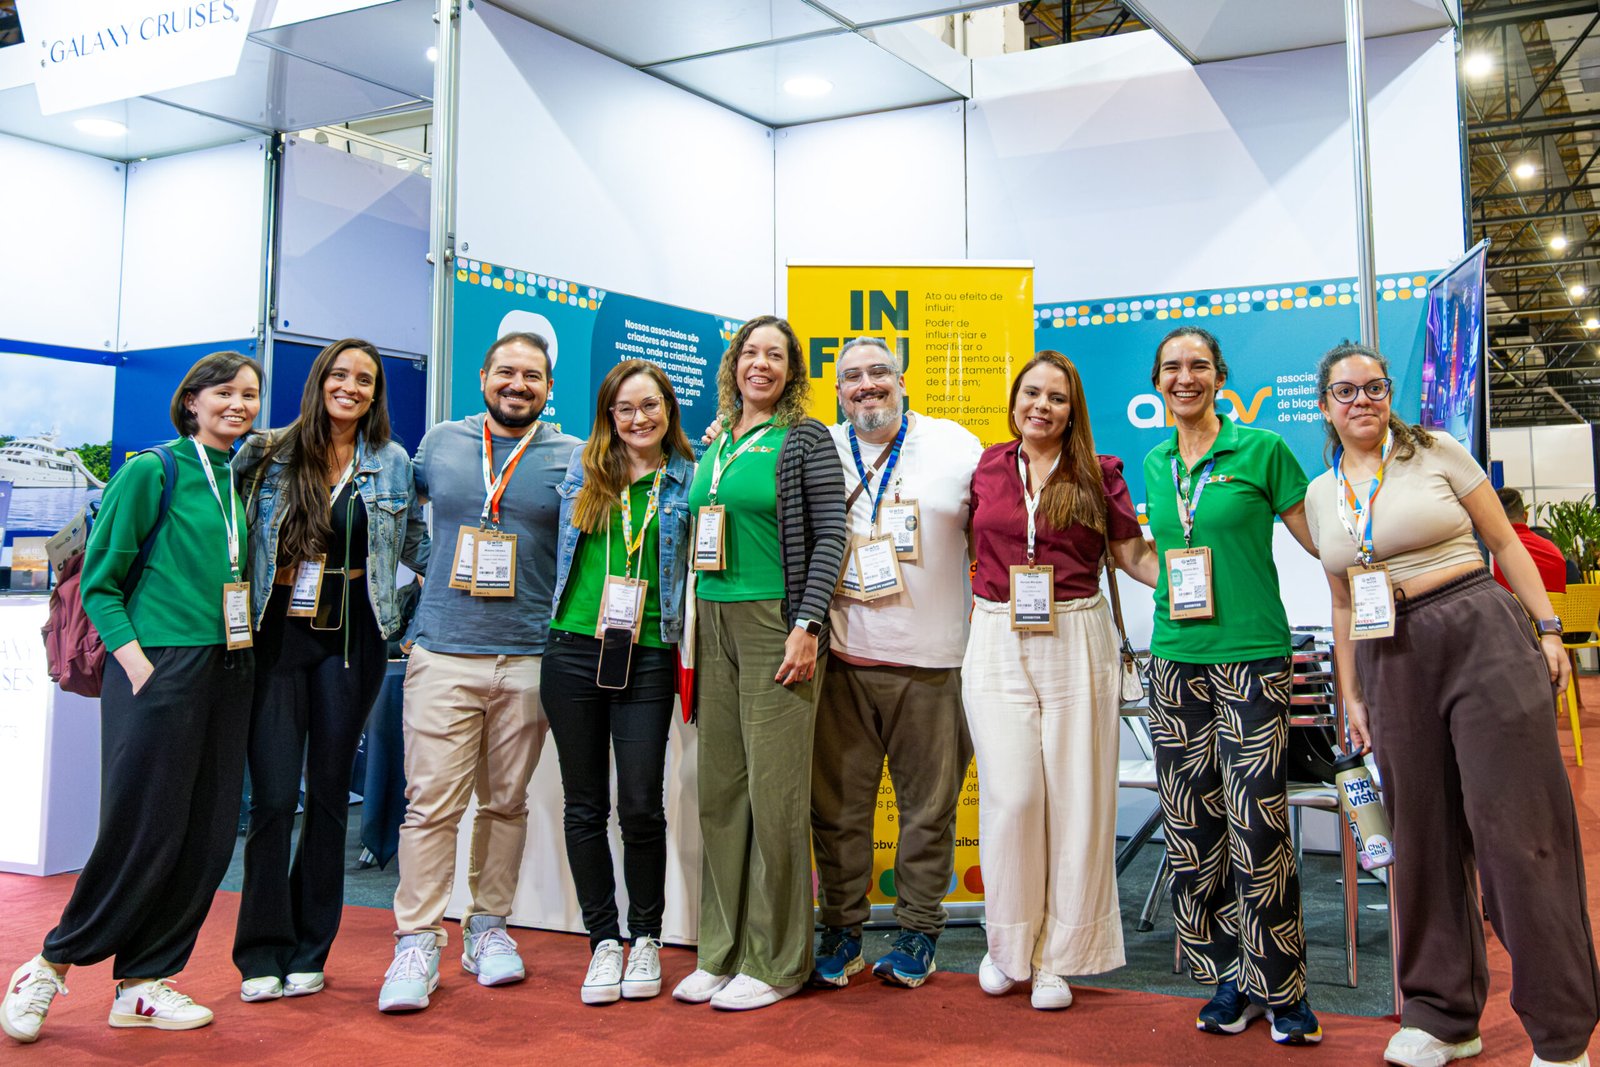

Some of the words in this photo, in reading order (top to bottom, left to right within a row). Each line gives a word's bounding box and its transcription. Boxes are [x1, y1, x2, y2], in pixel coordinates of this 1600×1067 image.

[50, 21, 133, 63] GALAXY
[140, 0, 235, 40] CRUISES
[925, 292, 942, 300] Ato
[944, 293, 957, 301] ou
[959, 292, 987, 301] efeito
[990, 292, 1003, 301] de
[850, 290, 909, 331] IN
[925, 303, 955, 313] influir;
[925, 319, 954, 328] Poder
[956, 319, 969, 328] de
[625, 319, 649, 332] Nossos
[650, 326, 687, 340] associados
[688, 333, 699, 343] são
[925, 330, 977, 339] influenciar
[627, 332, 659, 345] criadores
[660, 338, 668, 347] de
[669, 341, 688, 351] cases
[689, 344, 697, 353] de
[925, 342, 973, 351] modificar
[976, 343, 983, 351] o
[615, 341, 645, 355] sucesso,
[646, 347, 663, 358] onde
[669, 351, 707, 366] criatividade
[926, 355, 990, 364] pensamento
[992, 355, 1005, 363] ou
[1007, 355, 1014, 363] o
[667, 361, 703, 376] caminham
[926, 365, 1009, 375] comportamento
[683, 374, 705, 388] digital,
[926, 378, 939, 386] de
[942, 378, 981, 388] outrem;
[685, 389, 701, 398] para
[1277, 384, 1318, 397] brasileir
[926, 393, 955, 402] Poder
[957, 394, 970, 402] ou
[1277, 399, 1290, 409] de
[1292, 398, 1319, 410] blogs
[926, 405, 1008, 416] preponderância
[957, 417, 990, 426] outros
[1278, 412, 1291, 422] de
[1343, 778, 1370, 793] haja
